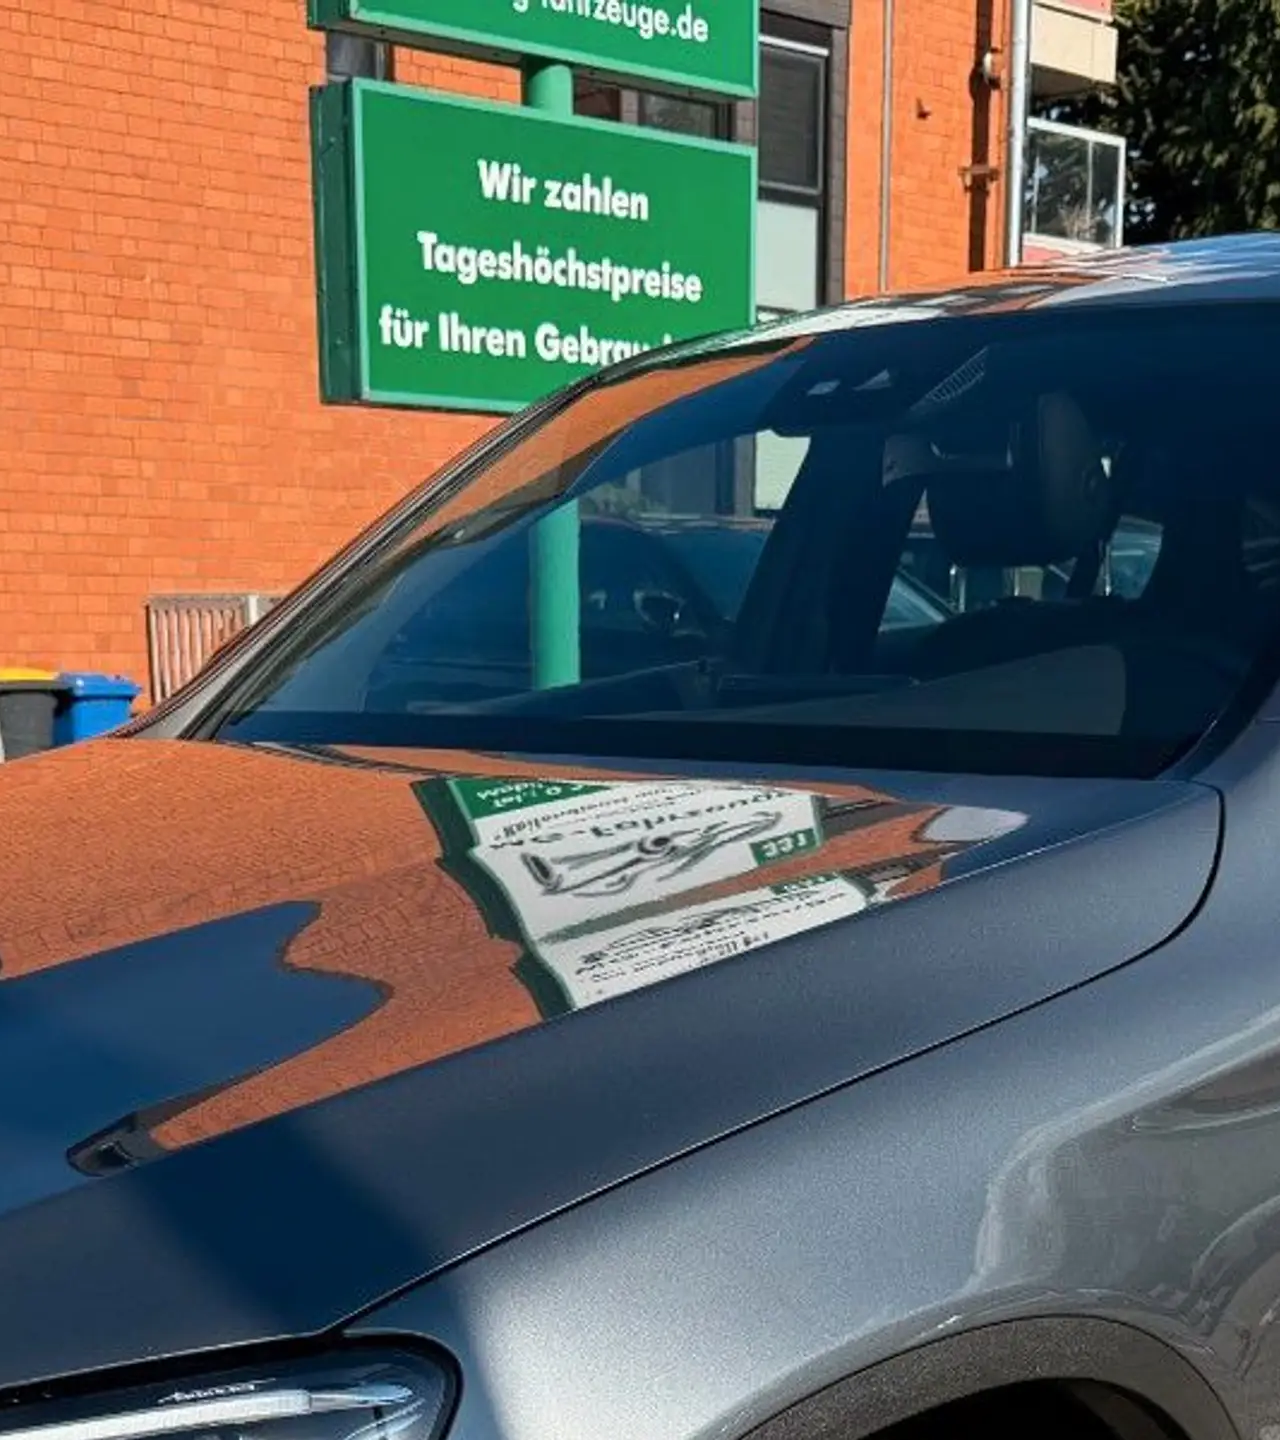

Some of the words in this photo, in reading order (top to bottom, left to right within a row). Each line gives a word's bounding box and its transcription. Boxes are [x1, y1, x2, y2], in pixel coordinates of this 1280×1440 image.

[477, 158, 537, 205] Wir
[543, 173, 649, 221] zahlen
[417, 230, 703, 302] Tageshöchstpreise
[379, 304, 430, 349] für
[438, 311, 526, 359] Ihren
